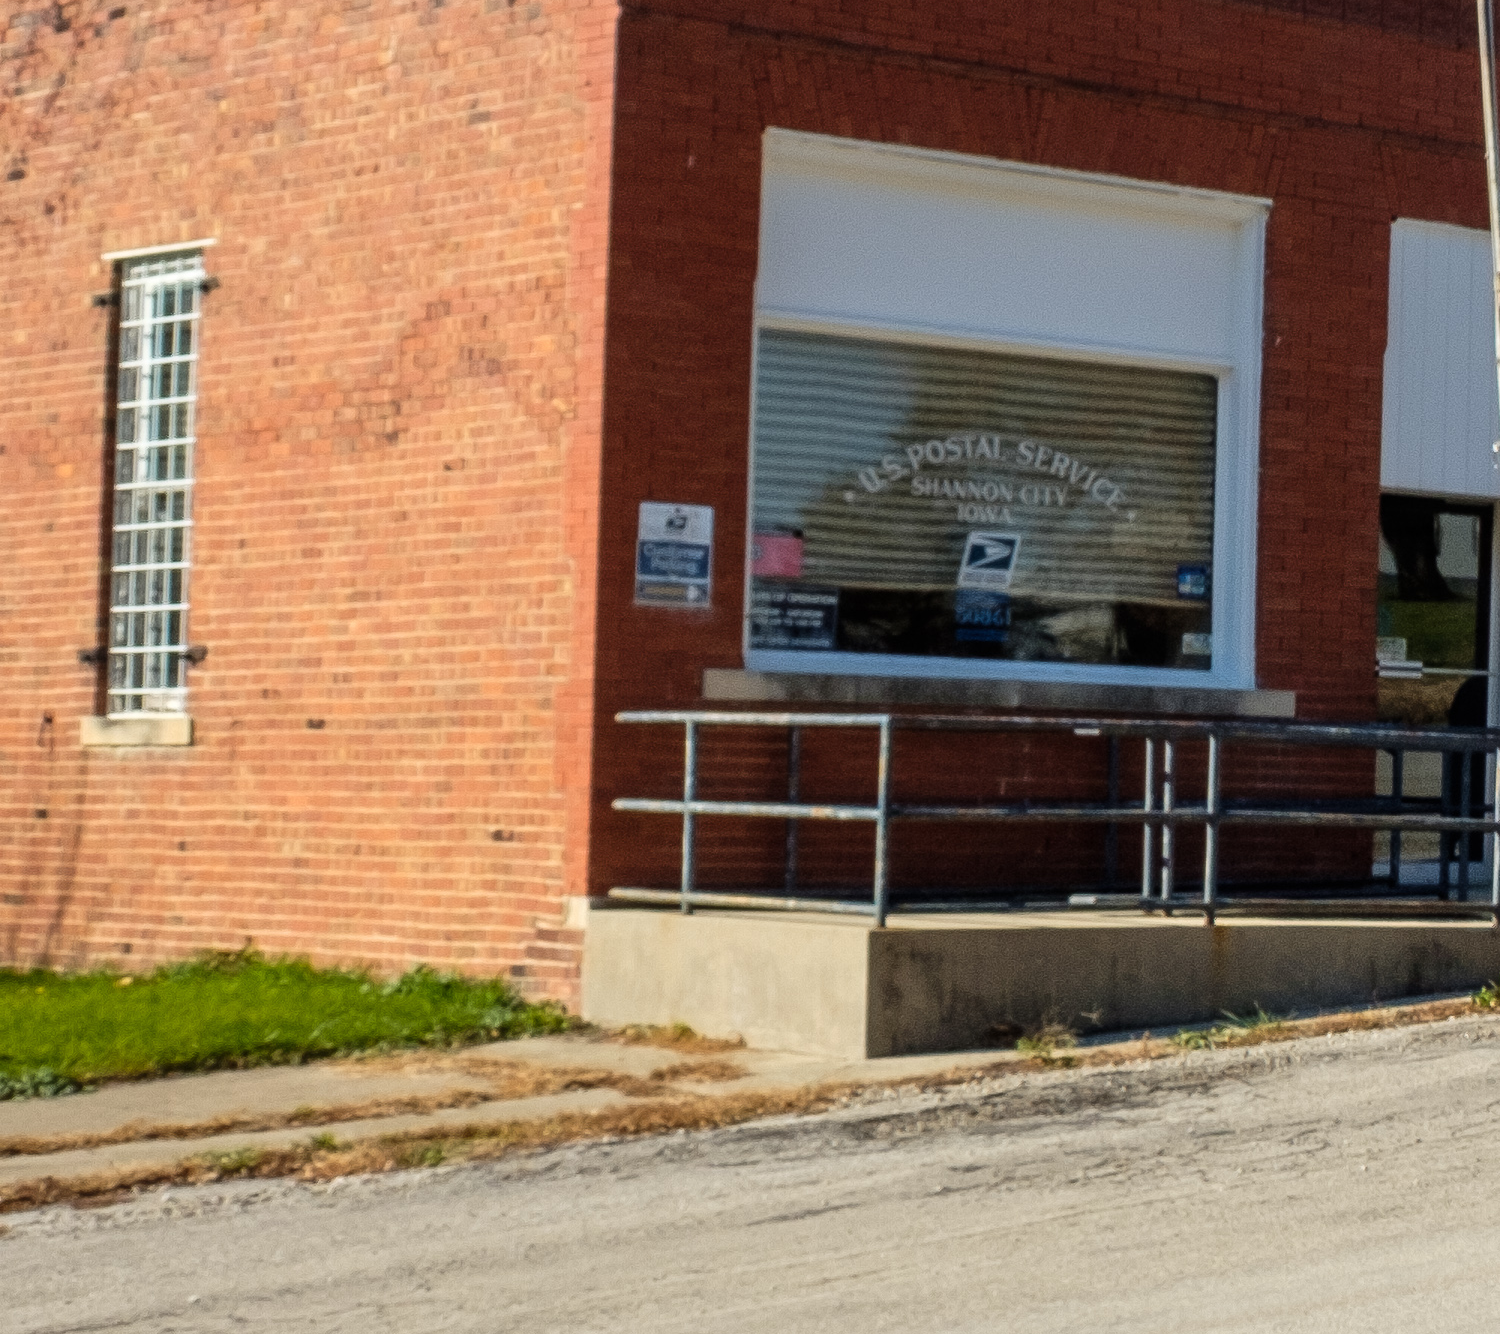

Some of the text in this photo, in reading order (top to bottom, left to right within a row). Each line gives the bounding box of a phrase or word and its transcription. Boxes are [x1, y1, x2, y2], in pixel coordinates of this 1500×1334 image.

[906, 433, 1003, 472] POSTAL
[1016, 436, 1129, 512] SERVICE
[910, 475, 1069, 507] SHANNON CITY
[956, 502, 1013, 523] IOWA
